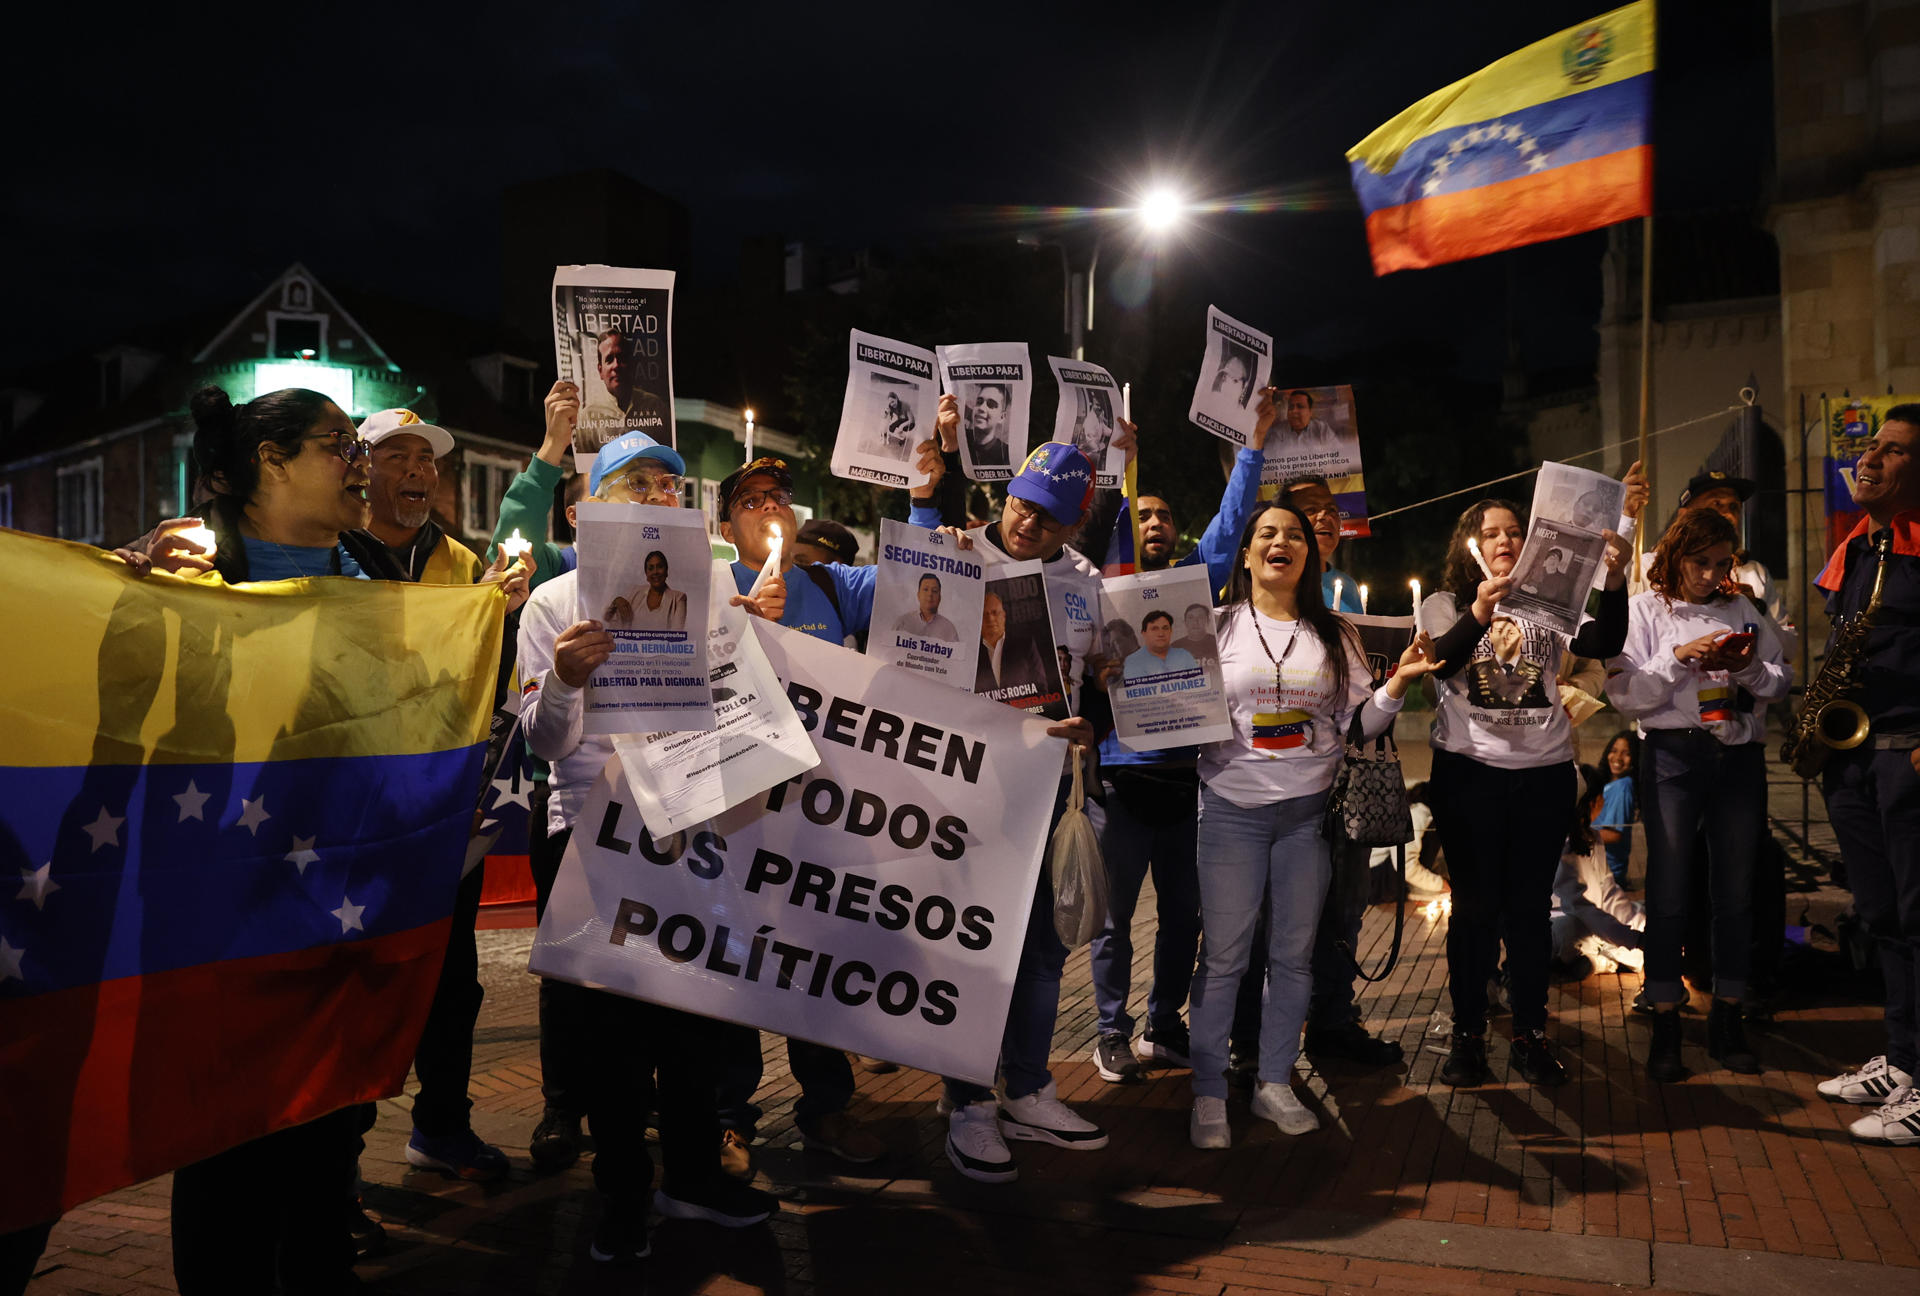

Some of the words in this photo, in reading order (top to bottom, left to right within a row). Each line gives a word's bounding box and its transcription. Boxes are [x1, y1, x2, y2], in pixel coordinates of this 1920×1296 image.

[581, 303, 603, 311] pueblo
[608, 297, 625, 305] poder
[1214, 319, 1246, 341] LIBERTAD
[1247, 335, 1266, 351] PARA
[859, 346, 904, 366] LIBERTAD
[905, 358, 930, 374] PARA
[951, 366, 995, 377] LIBERTAD
[996, 365, 1020, 376] PARA
[1062, 370, 1092, 381] LIBERTAD
[1092, 373, 1110, 384] PARA
[576, 420, 597, 429] JUAN
[599, 419, 626, 429] PABLO
[626, 417, 663, 427] GUANIPA
[1264, 457, 1285, 465] amos
[1287, 456, 1298, 464] por
[1309, 451, 1339, 460] Libertad
[1292, 462, 1317, 470] presos
[850, 467, 881, 481] MARIELA
[882, 474, 906, 485] OJEDA
[641, 532, 661, 540] VZLA
[643, 526, 659, 534] CON
[930, 532, 943, 540] CON
[928, 537, 944, 545] VZLA
[884, 544, 982, 580] SECUESTRADO
[1065, 592, 1087, 609] CON
[896, 635, 918, 650] Luis
[919, 640, 953, 658] Tarbay
[1520, 641, 1552, 657] LITICO
[640, 677, 663, 687] PARA
[664, 677, 705, 687] DIGNORA!
[1126, 686, 1158, 699] HENRY
[1160, 678, 1206, 694] ALVIAREZ
[1007, 682, 1038, 698] ROCHA
[1250, 688, 1256, 696] y
[1308, 689, 1318, 698] de
[663, 738, 691, 752] Oriundo
[692, 733, 703, 741] del
[726, 711, 752, 727] Barinas
[786, 681, 987, 785] BEREN
[595, 801, 728, 880] LOS
[744, 847, 995, 951] PRESOS
[609, 897, 960, 1026] POLÍTICOS
